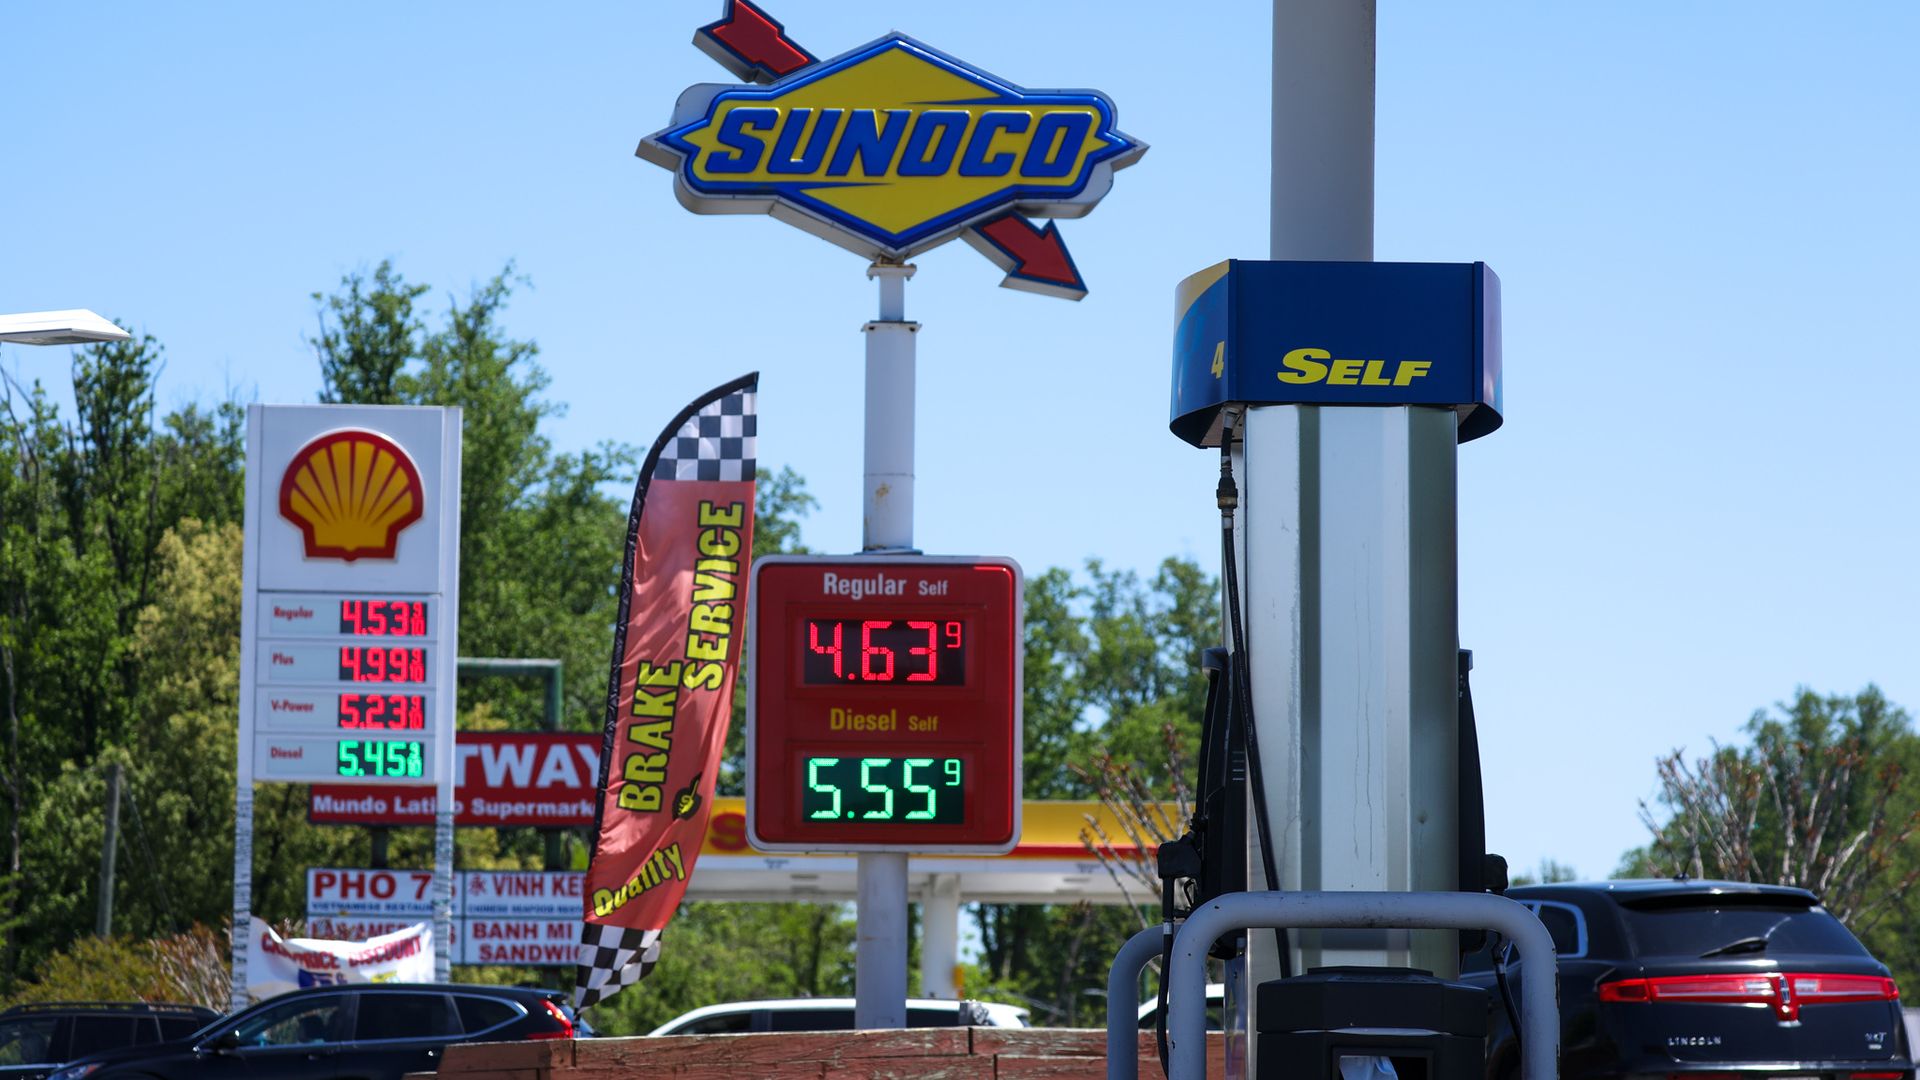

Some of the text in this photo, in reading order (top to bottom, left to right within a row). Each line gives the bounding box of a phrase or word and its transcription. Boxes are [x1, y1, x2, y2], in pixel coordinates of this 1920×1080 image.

[704, 107, 1093, 178] SUNOCO
[1211, 341, 1225, 379] 4
[1277, 348, 1432, 386] SELF
[682, 499, 745, 691] SERVICE
[823, 573, 949, 600] Regular Self
[273, 606, 313, 621] Regular
[272, 653, 294, 665] Plus
[809, 621, 937, 681] 4.63
[271, 700, 314, 712] V-Power
[830, 708, 939, 732] Diesel Self
[617, 659, 683, 812] BRAKE
[270, 747, 303, 758] Diesel
[808, 757, 937, 820] 5.55
[313, 795, 388, 815] Mundo
[394, 796, 464, 816] Latio
[313, 871, 397, 899] PHO
[492, 874, 586, 897] VINH KE
[592, 842, 685, 917] Quality
[472, 923, 538, 939] BANH
[547, 923, 573, 939] MI
[1668, 1035, 1722, 1047] LINCOLN
